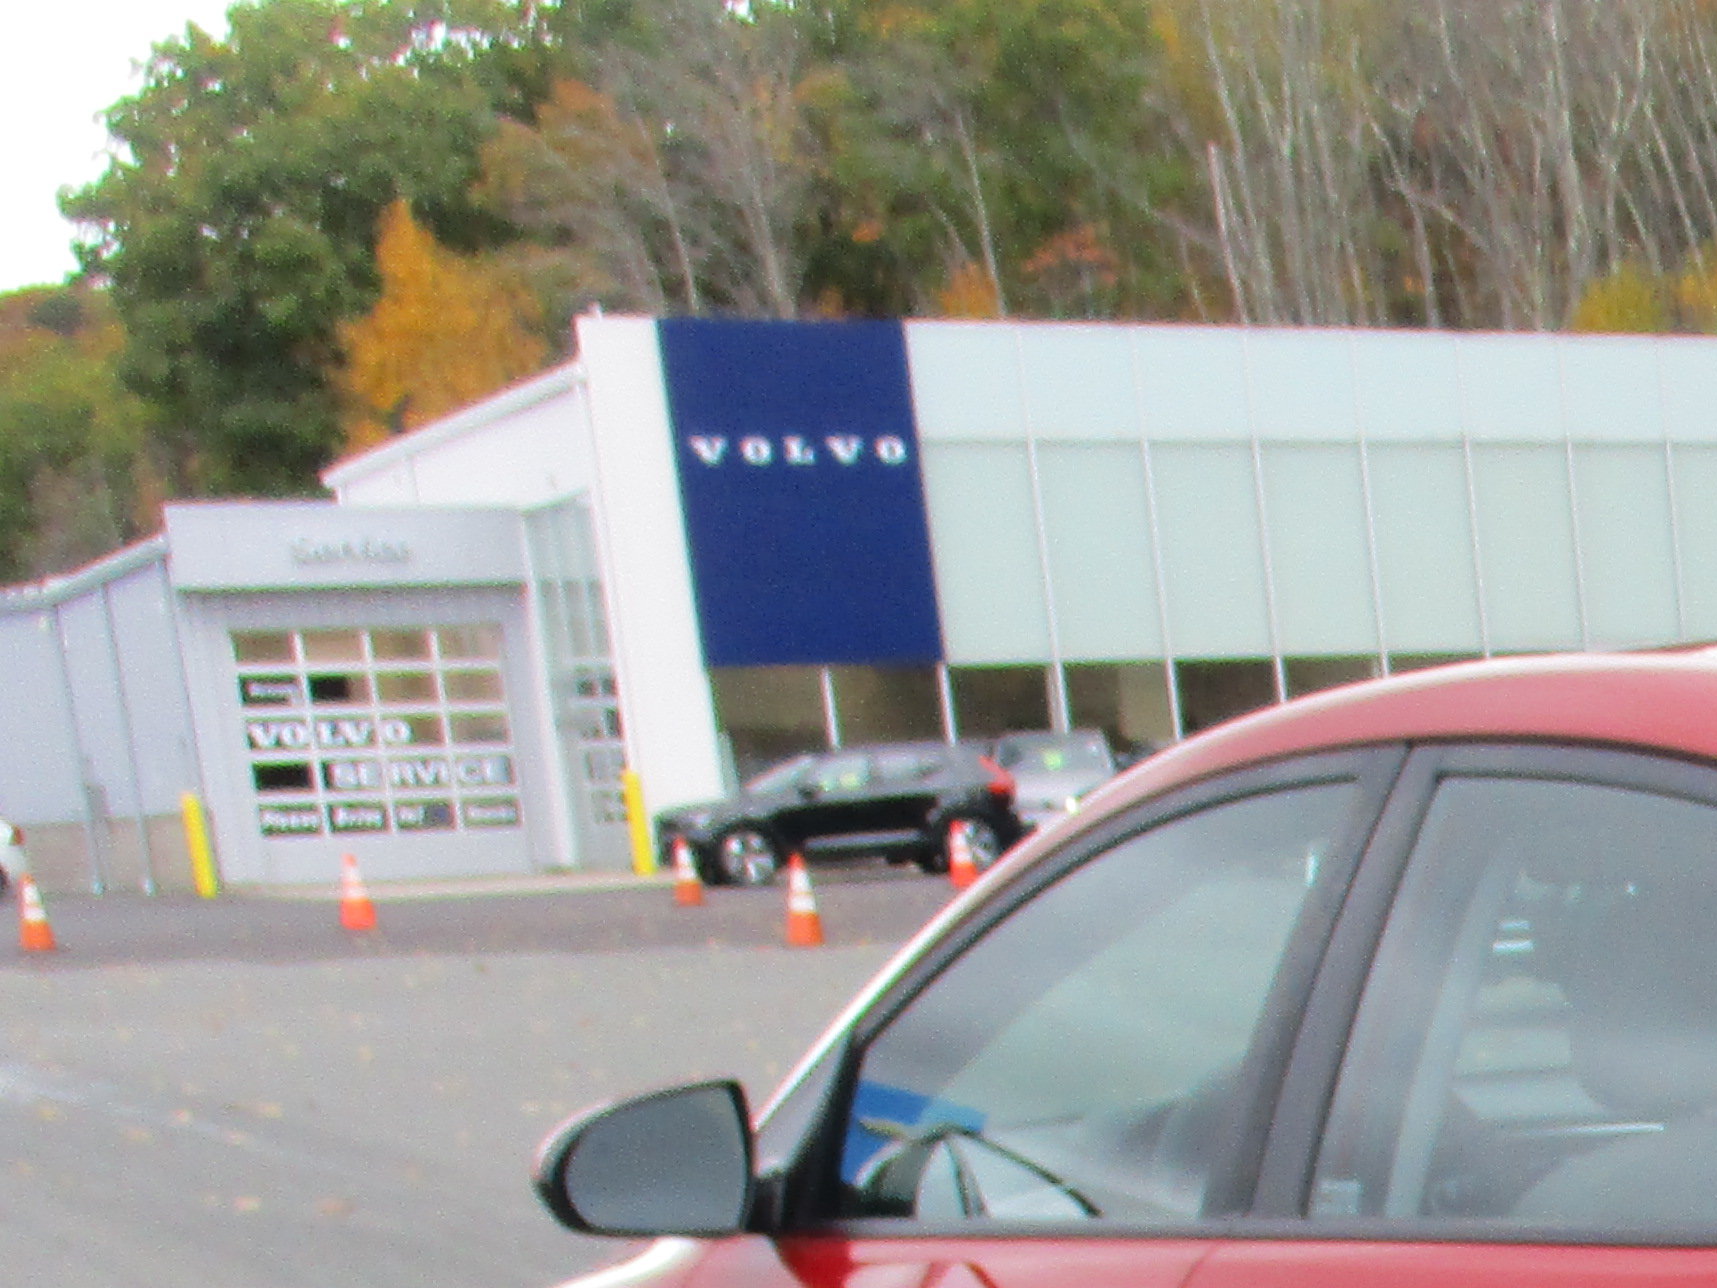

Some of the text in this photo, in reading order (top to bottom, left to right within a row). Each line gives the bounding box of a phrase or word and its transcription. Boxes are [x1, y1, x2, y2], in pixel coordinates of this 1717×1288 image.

[688, 434, 907, 466] VOLVO
[248, 719, 412, 748] VOLVO
[331, 758, 496, 788] SERVICE
